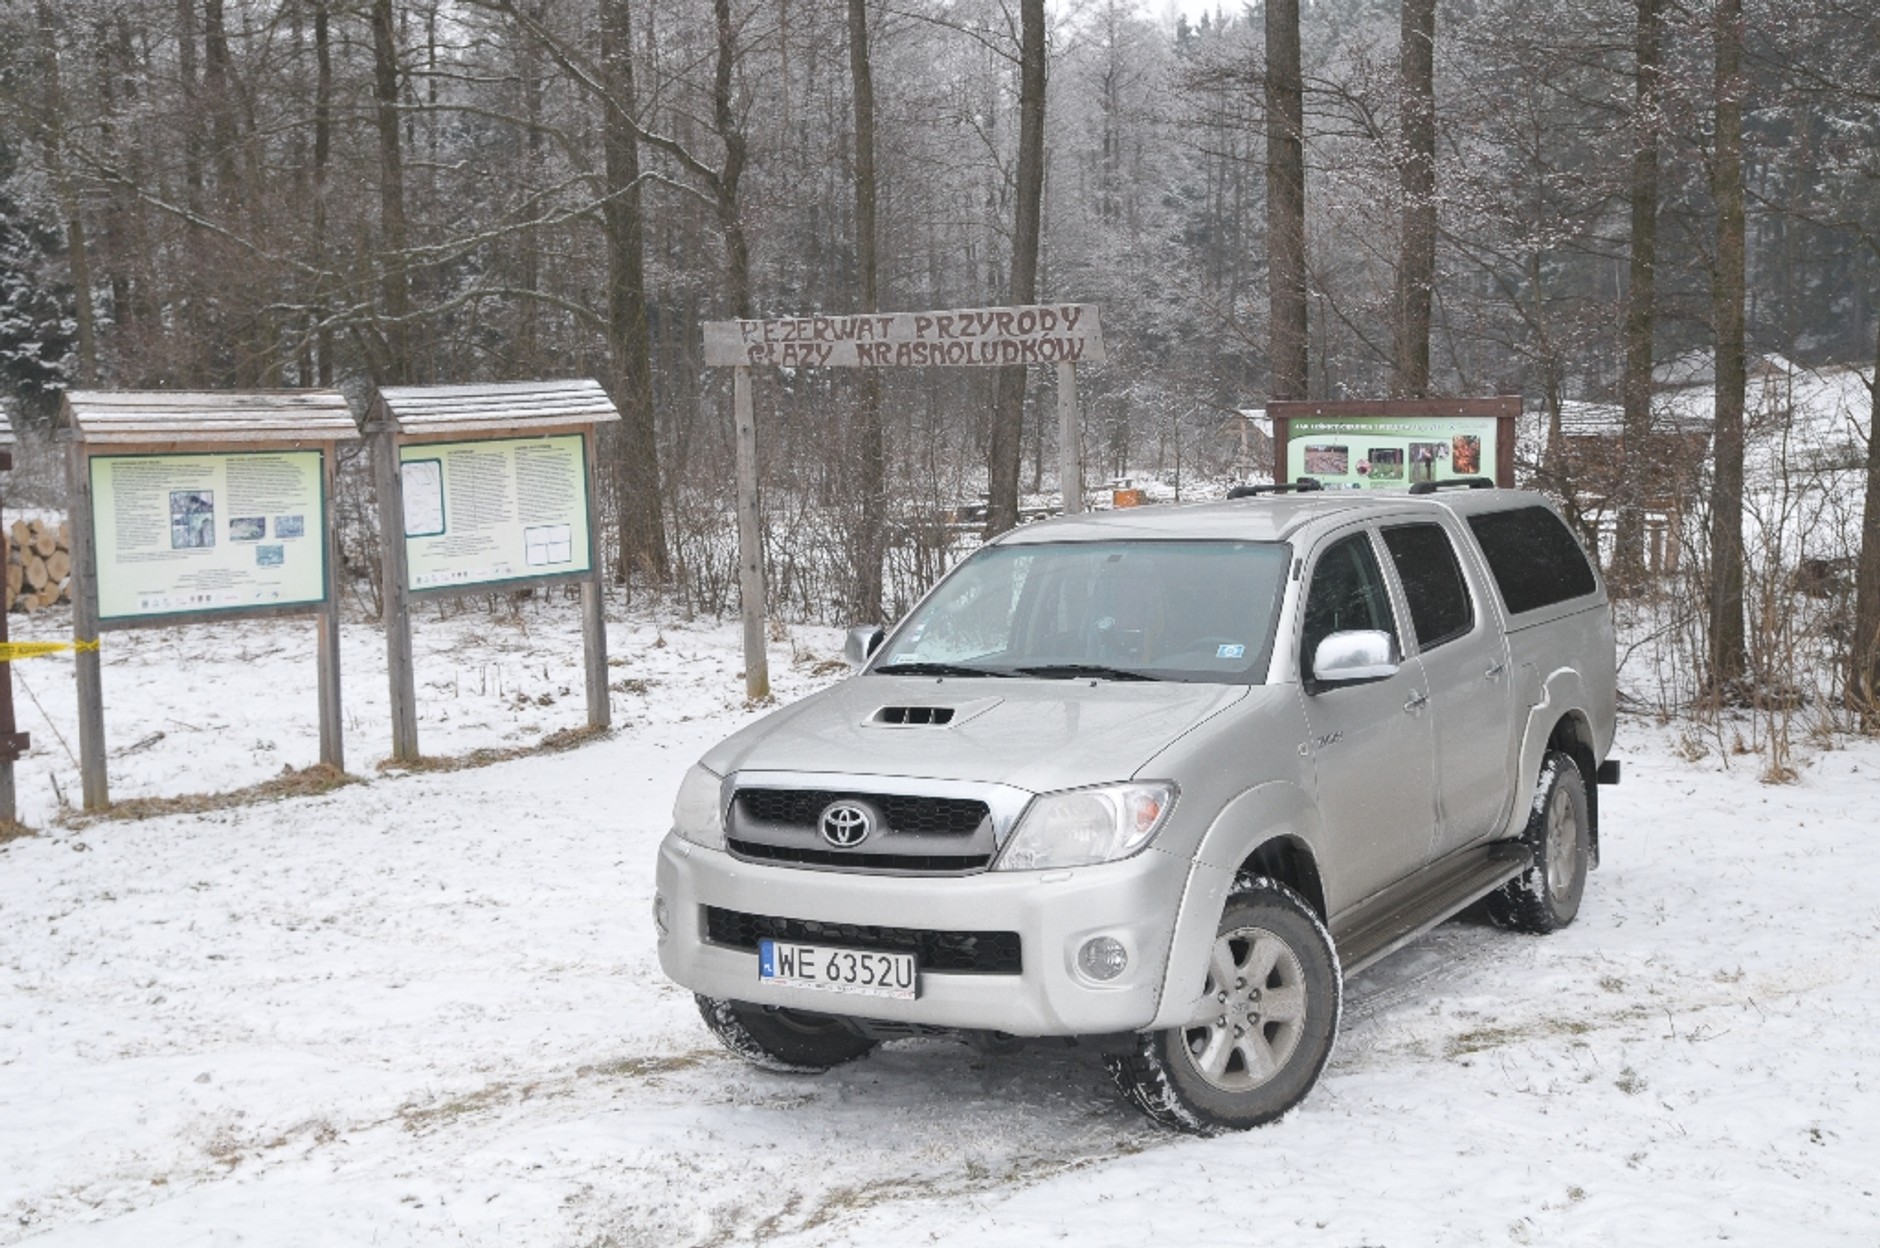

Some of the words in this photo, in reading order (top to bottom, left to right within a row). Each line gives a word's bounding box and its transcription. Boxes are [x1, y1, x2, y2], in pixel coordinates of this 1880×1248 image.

[740, 317, 895, 344] REZERWAT
[914, 307, 1082, 339] PRZYRODY
[747, 343, 833, 366] GŁAZY
[856, 333, 1084, 366] KRASNOLUDKÓW
[778, 946, 815, 979] WE
[826, 952, 912, 988] 6352U
